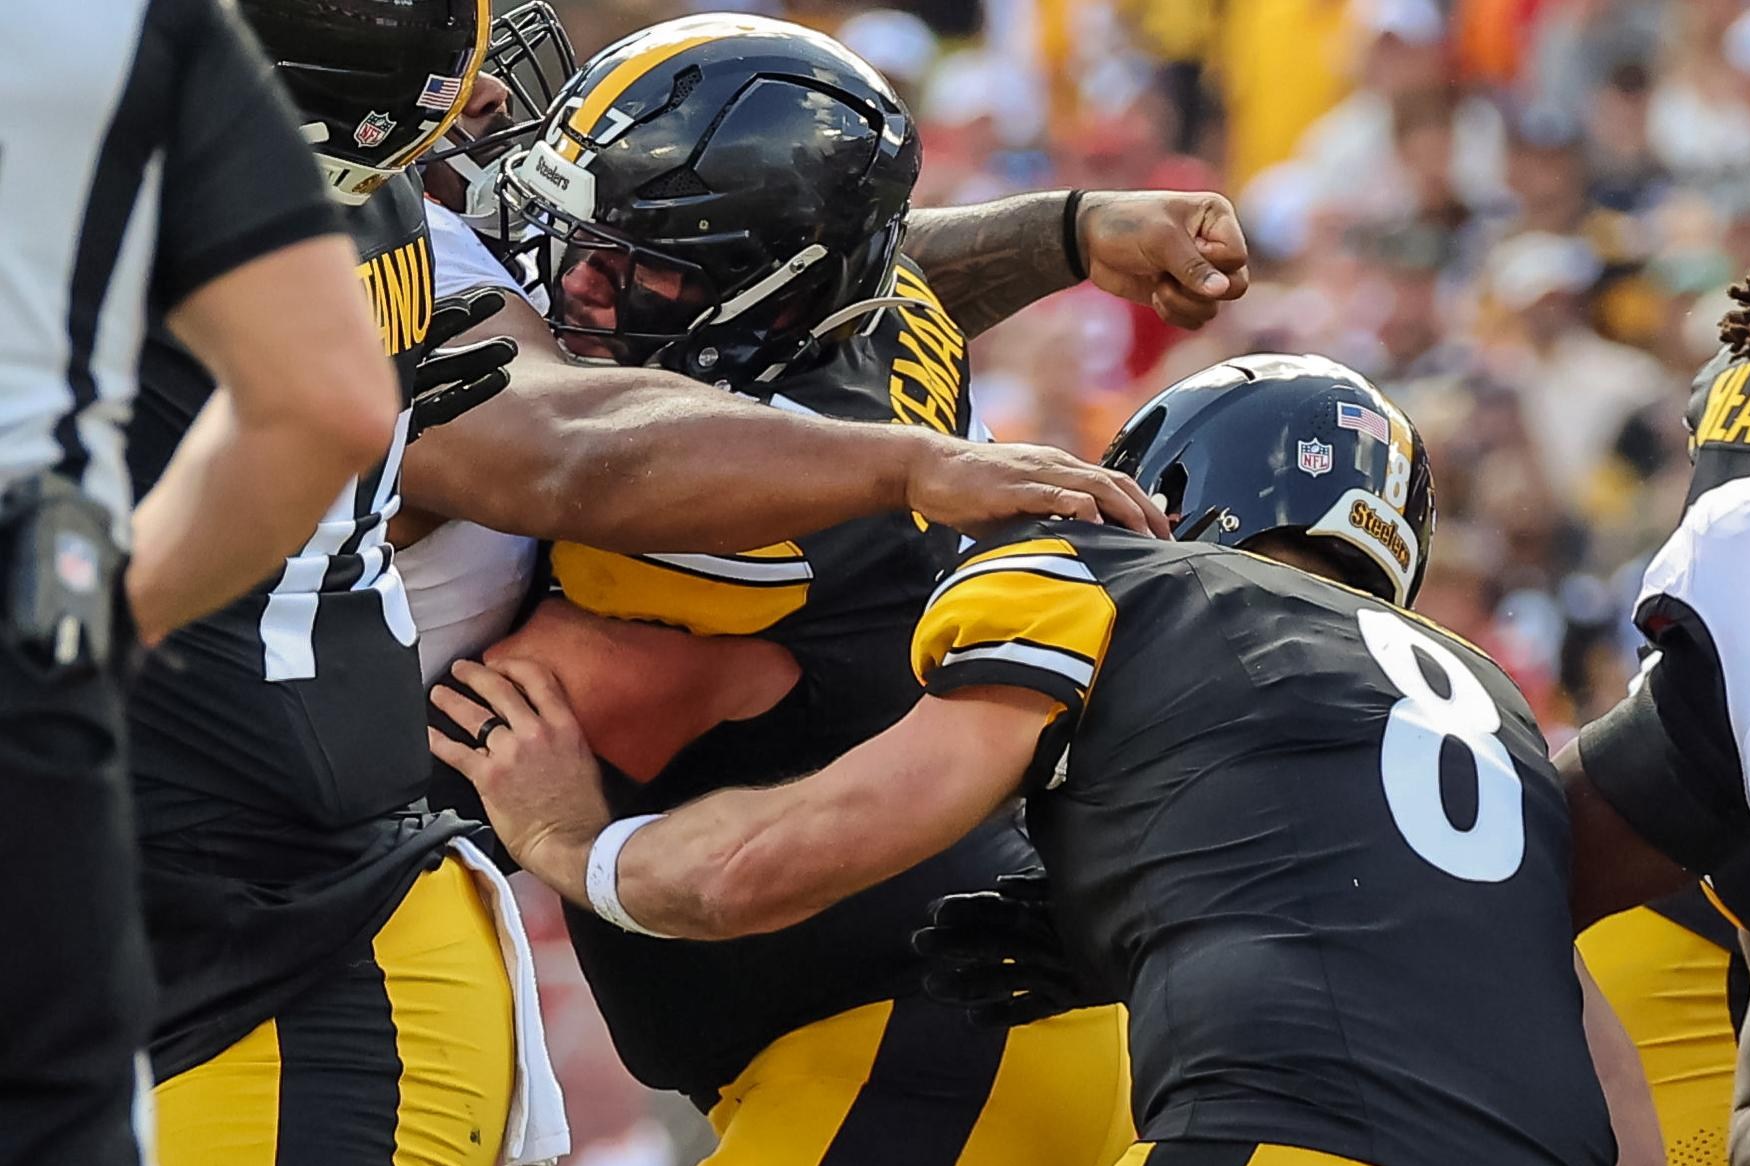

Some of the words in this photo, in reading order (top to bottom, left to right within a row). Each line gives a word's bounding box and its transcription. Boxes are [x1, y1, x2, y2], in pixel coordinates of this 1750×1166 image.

[535, 154, 571, 191] Steelers
[354, 236, 433, 357] TANU
[1303, 455, 1328, 469] NFL
[1384, 451, 1412, 509] 8
[1357, 608, 1526, 883] 8
